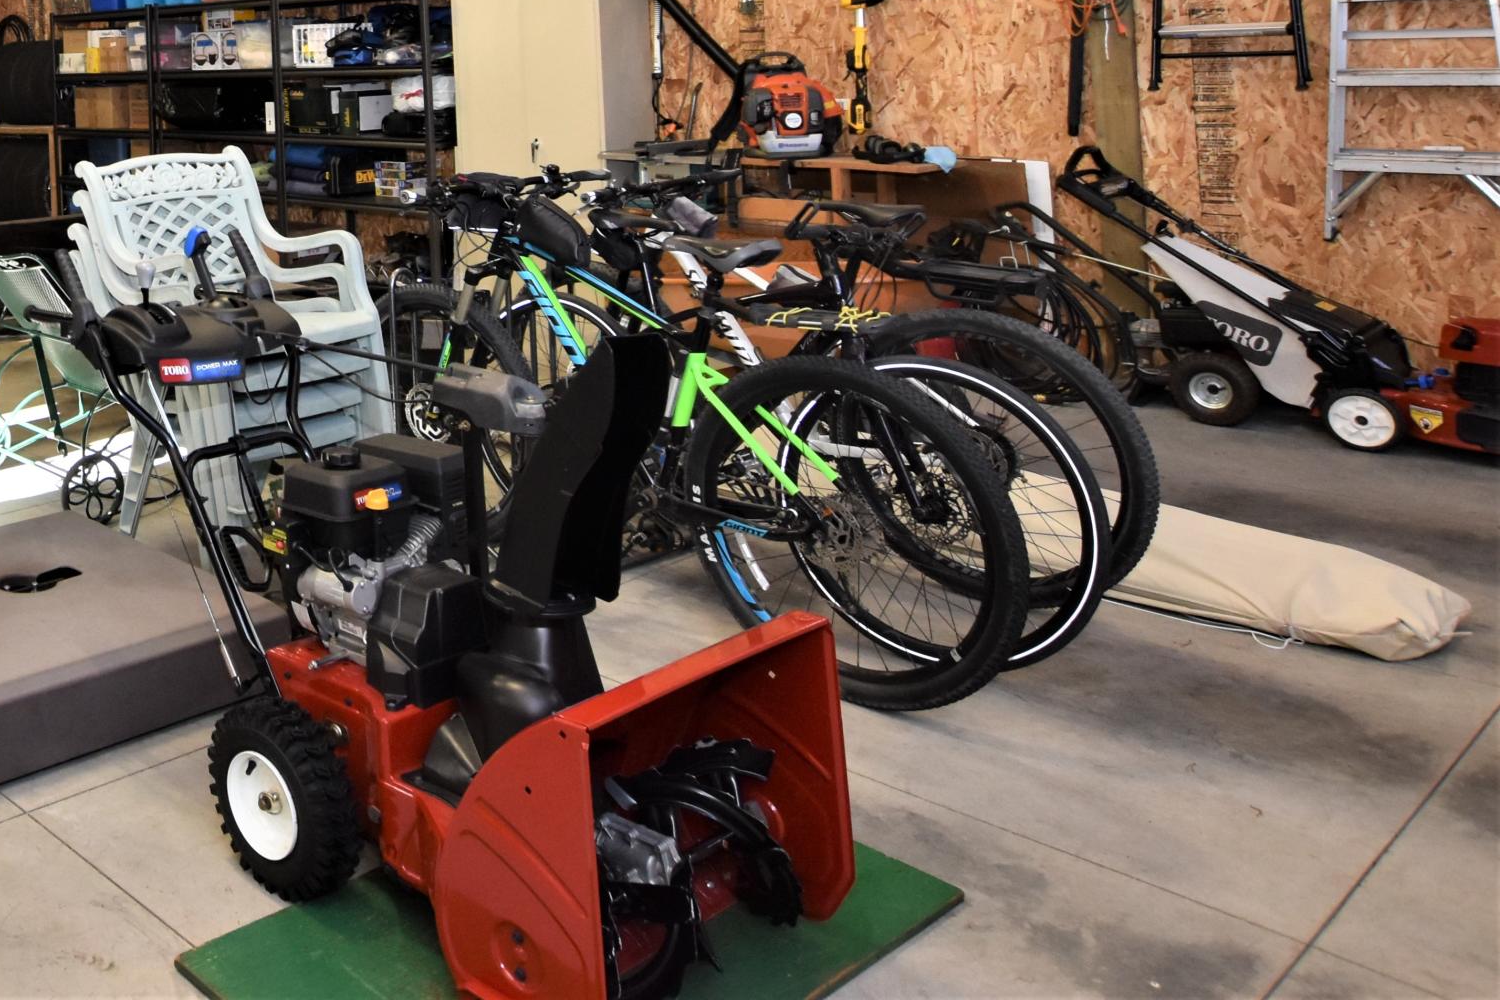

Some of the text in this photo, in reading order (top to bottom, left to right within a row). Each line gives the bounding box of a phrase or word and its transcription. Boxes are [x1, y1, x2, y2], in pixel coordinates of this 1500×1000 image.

[161, 359, 239, 376] TORO POWER MAX
